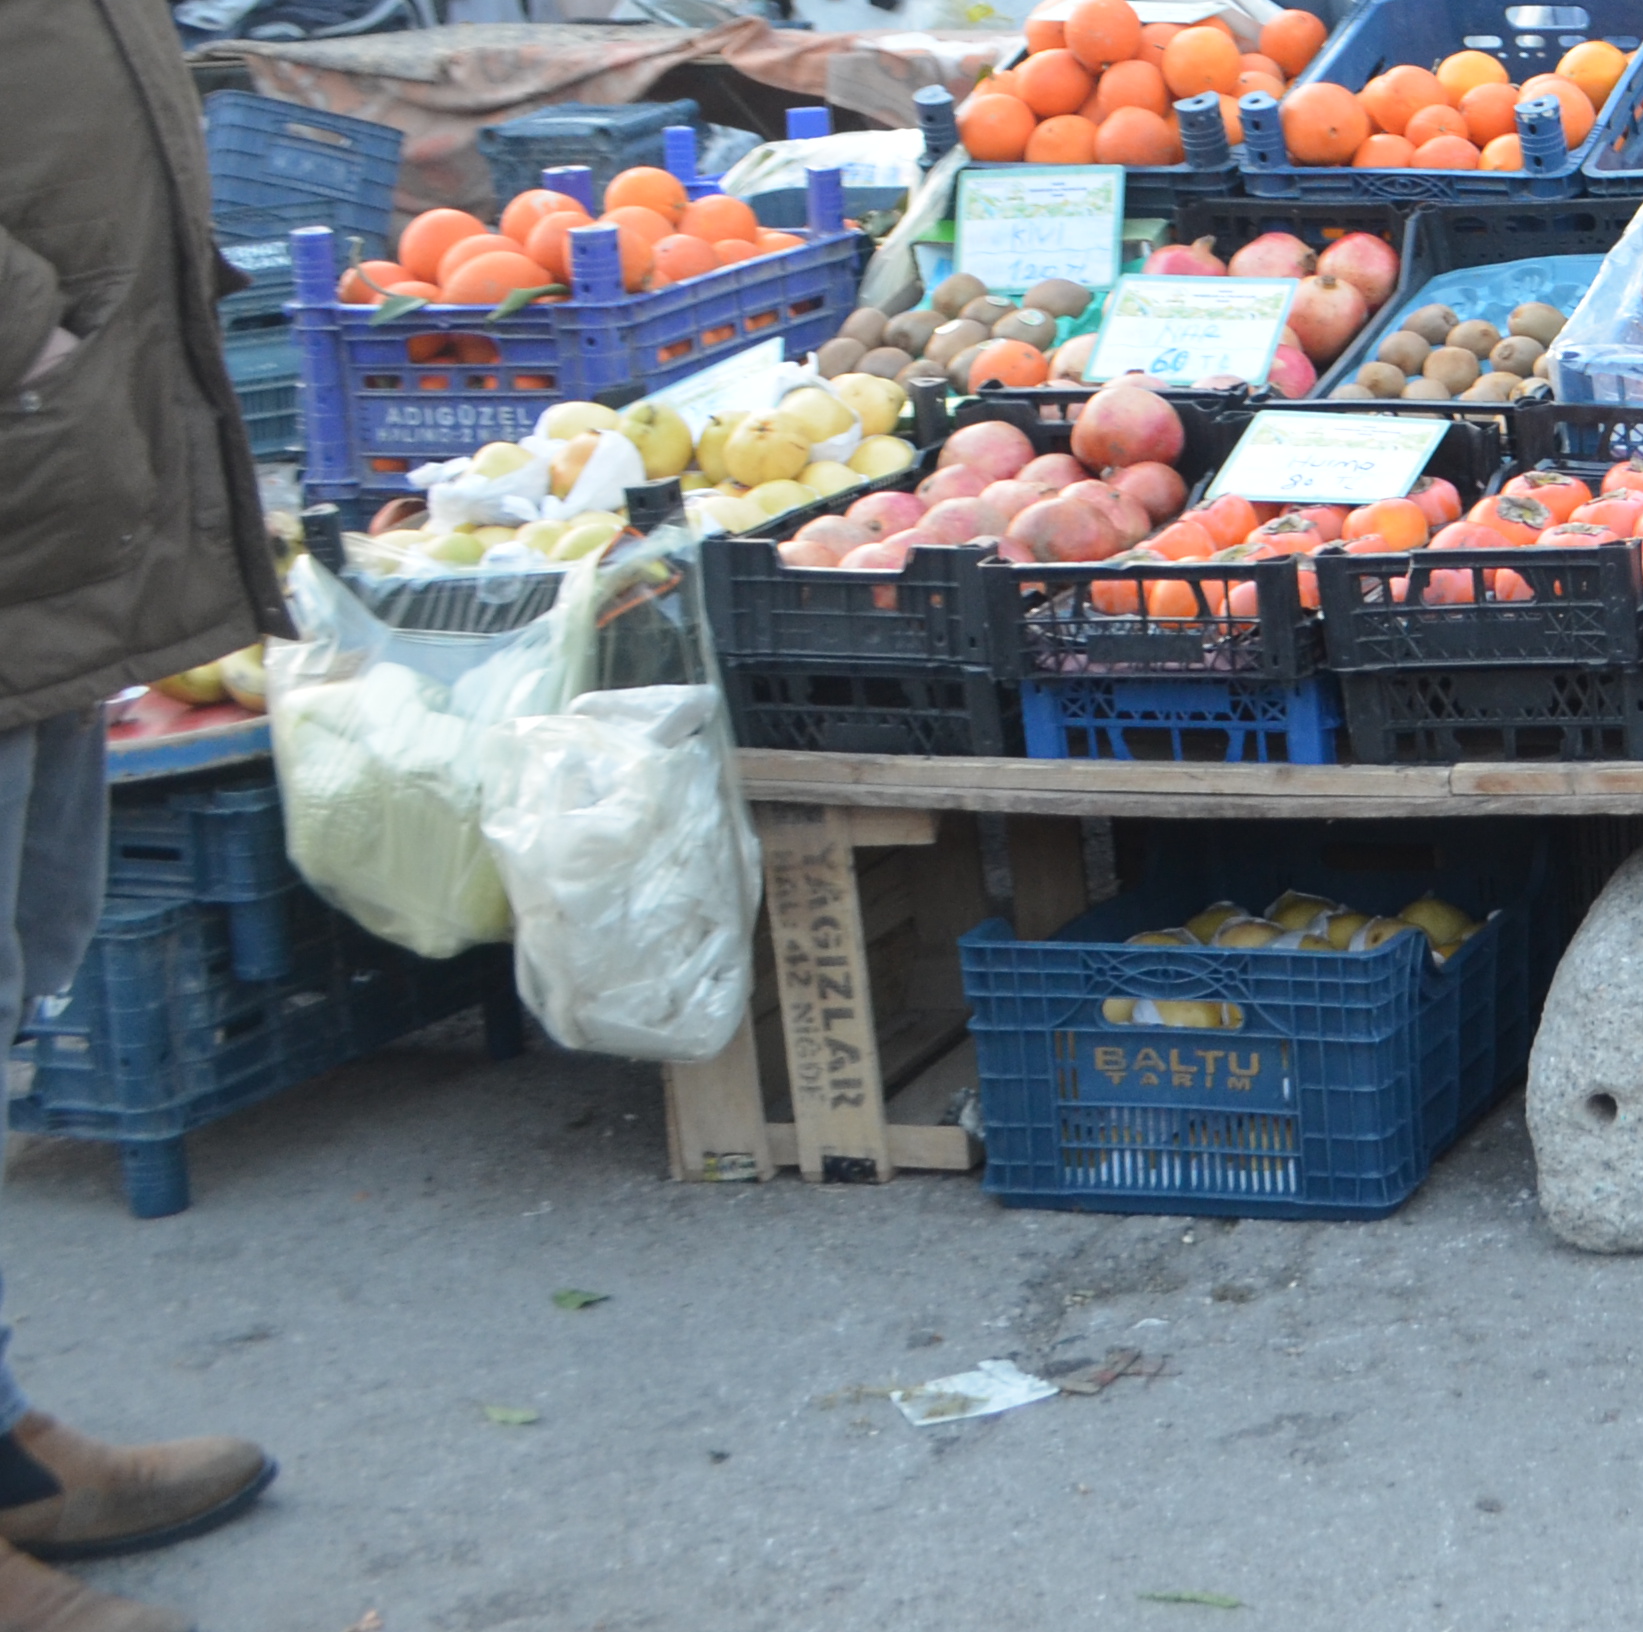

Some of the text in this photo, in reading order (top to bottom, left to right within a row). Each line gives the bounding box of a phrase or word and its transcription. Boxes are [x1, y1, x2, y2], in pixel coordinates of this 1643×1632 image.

[1150, 347, 1190, 374] 60
[1094, 1046, 1261, 1077] BALTU
[1105, 1069, 1252, 1091] TARIM
